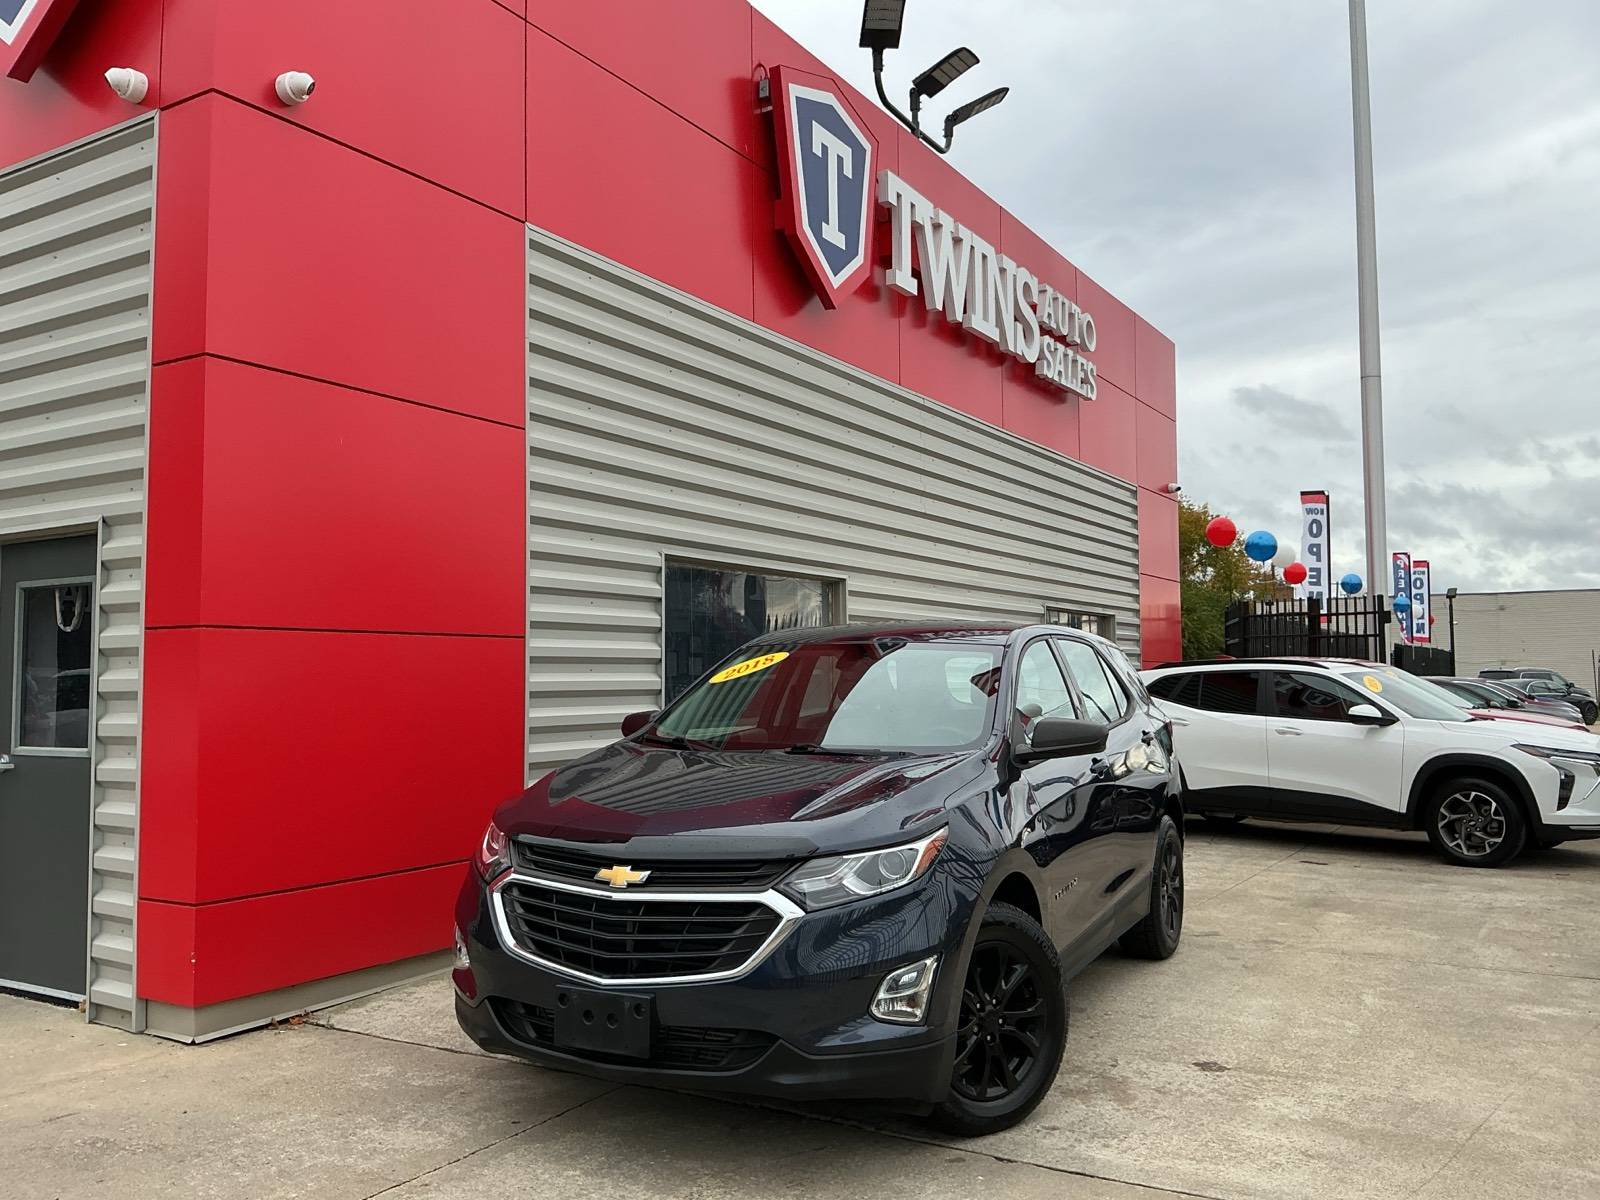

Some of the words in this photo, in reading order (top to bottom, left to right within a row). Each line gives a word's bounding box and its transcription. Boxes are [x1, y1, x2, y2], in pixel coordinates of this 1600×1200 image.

[812, 120, 853, 250] T
[878, 169, 1040, 363] TWINS
[1039, 284, 1096, 352] AUTO
[1036, 336, 1097, 401] SALES
[723, 655, 775, 679] 2018
